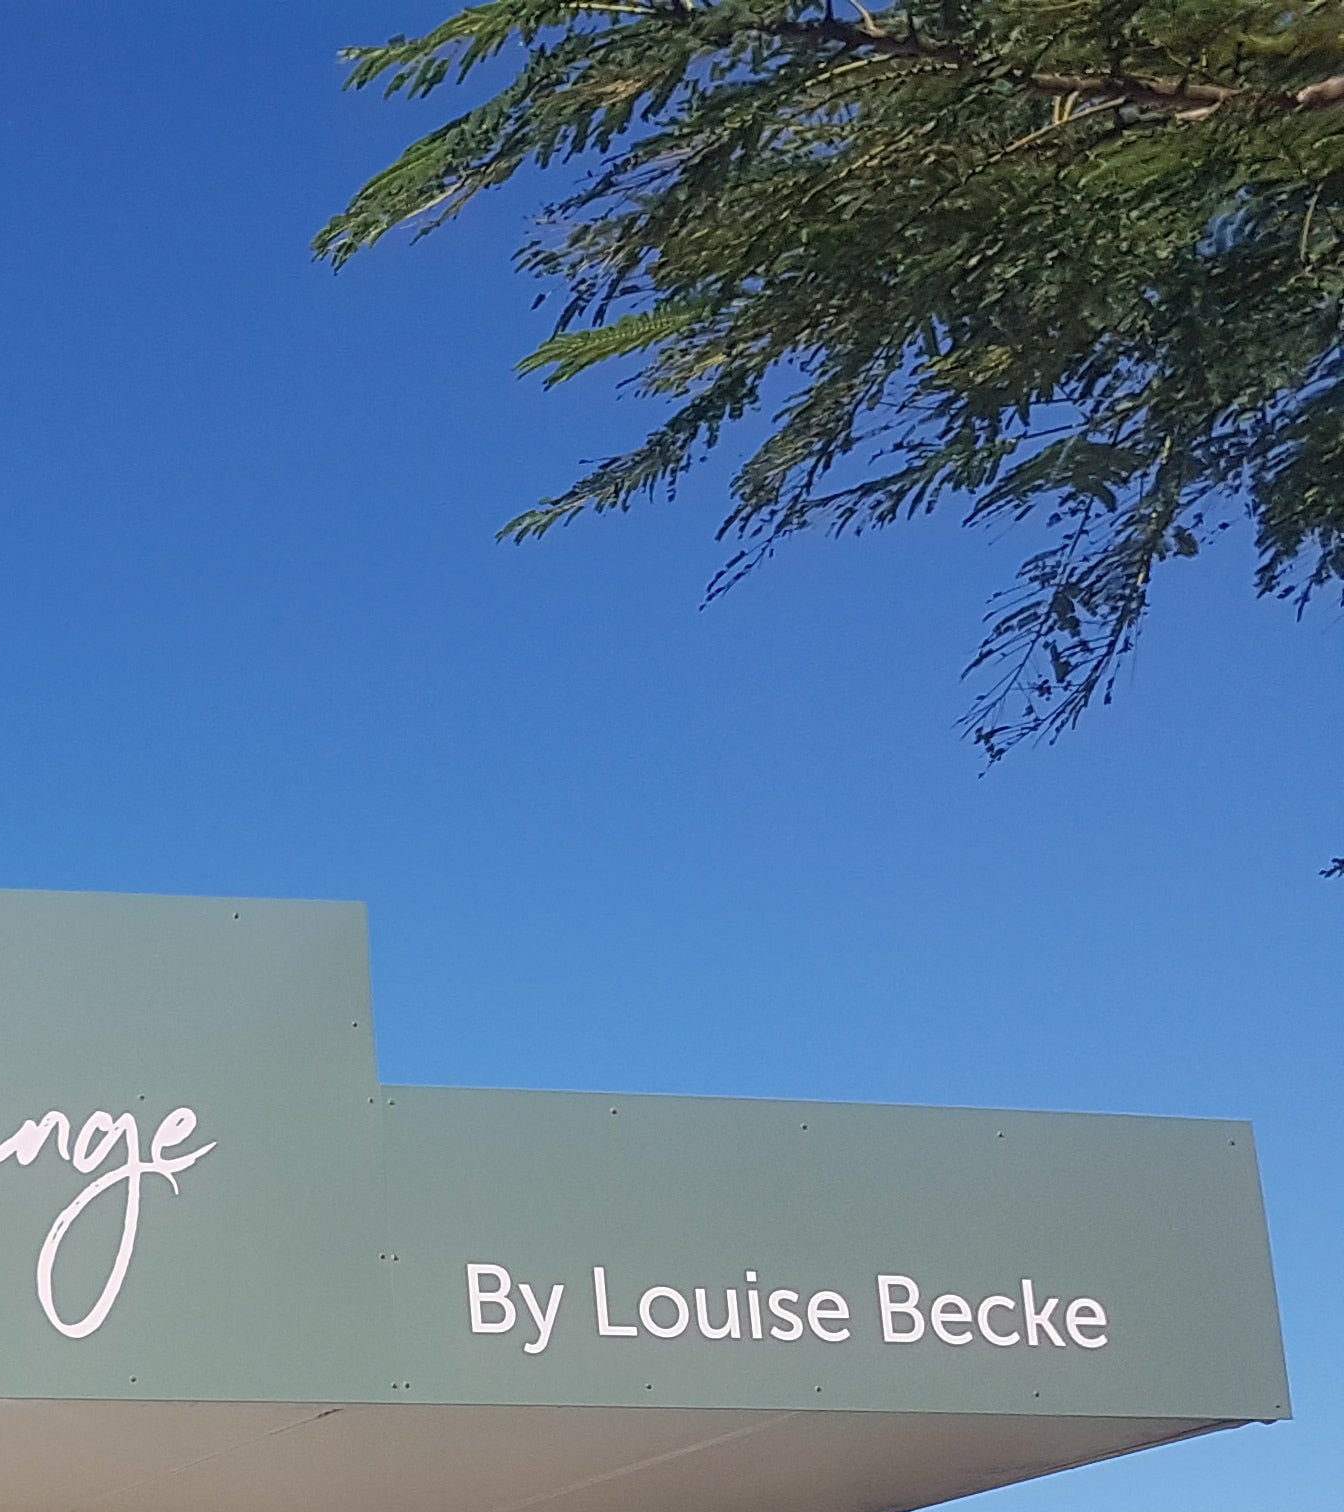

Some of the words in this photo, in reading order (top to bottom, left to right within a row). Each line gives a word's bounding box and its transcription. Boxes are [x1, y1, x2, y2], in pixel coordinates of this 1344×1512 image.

[466, 1262, 566, 1355] By
[592, 1266, 852, 1343] Louise
[876, 1273, 1110, 1350] Becke
